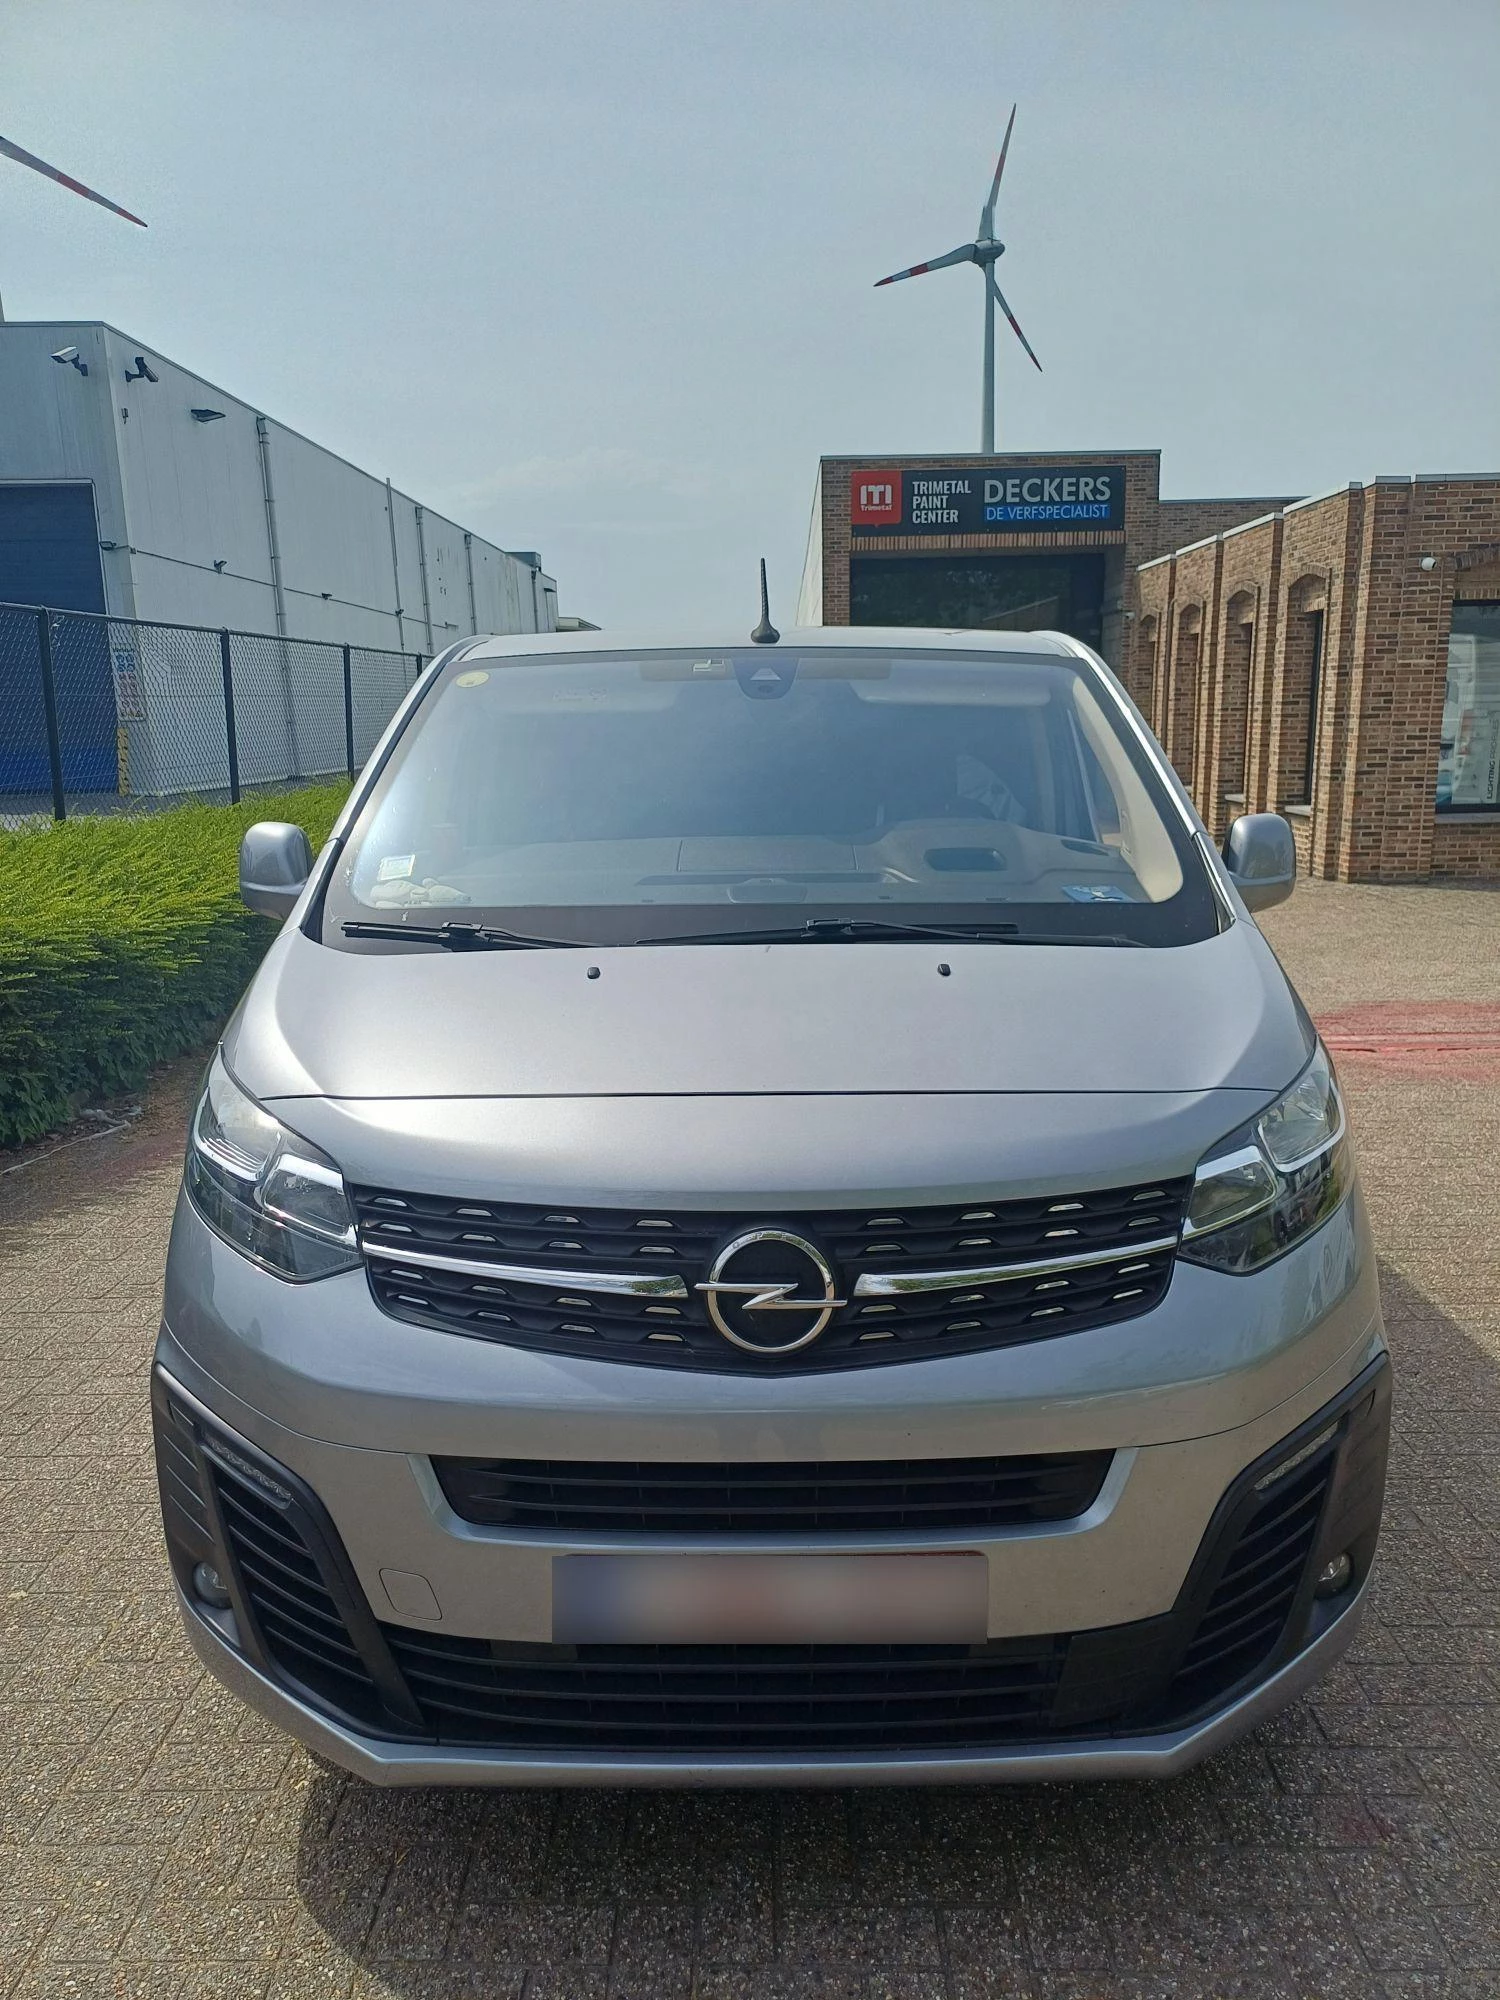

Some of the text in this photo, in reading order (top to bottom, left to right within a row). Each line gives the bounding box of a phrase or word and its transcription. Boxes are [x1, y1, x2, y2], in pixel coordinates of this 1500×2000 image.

[912, 480, 972, 494] TRIMETAL
[984, 476, 1111, 503] DECKERS
[912, 495, 949, 509] PAINT
[912, 509, 959, 523] CENTER
[986, 504, 1108, 520] DE VERFSPECIALIST
[1486, 760, 1496, 800] LIGHTING
